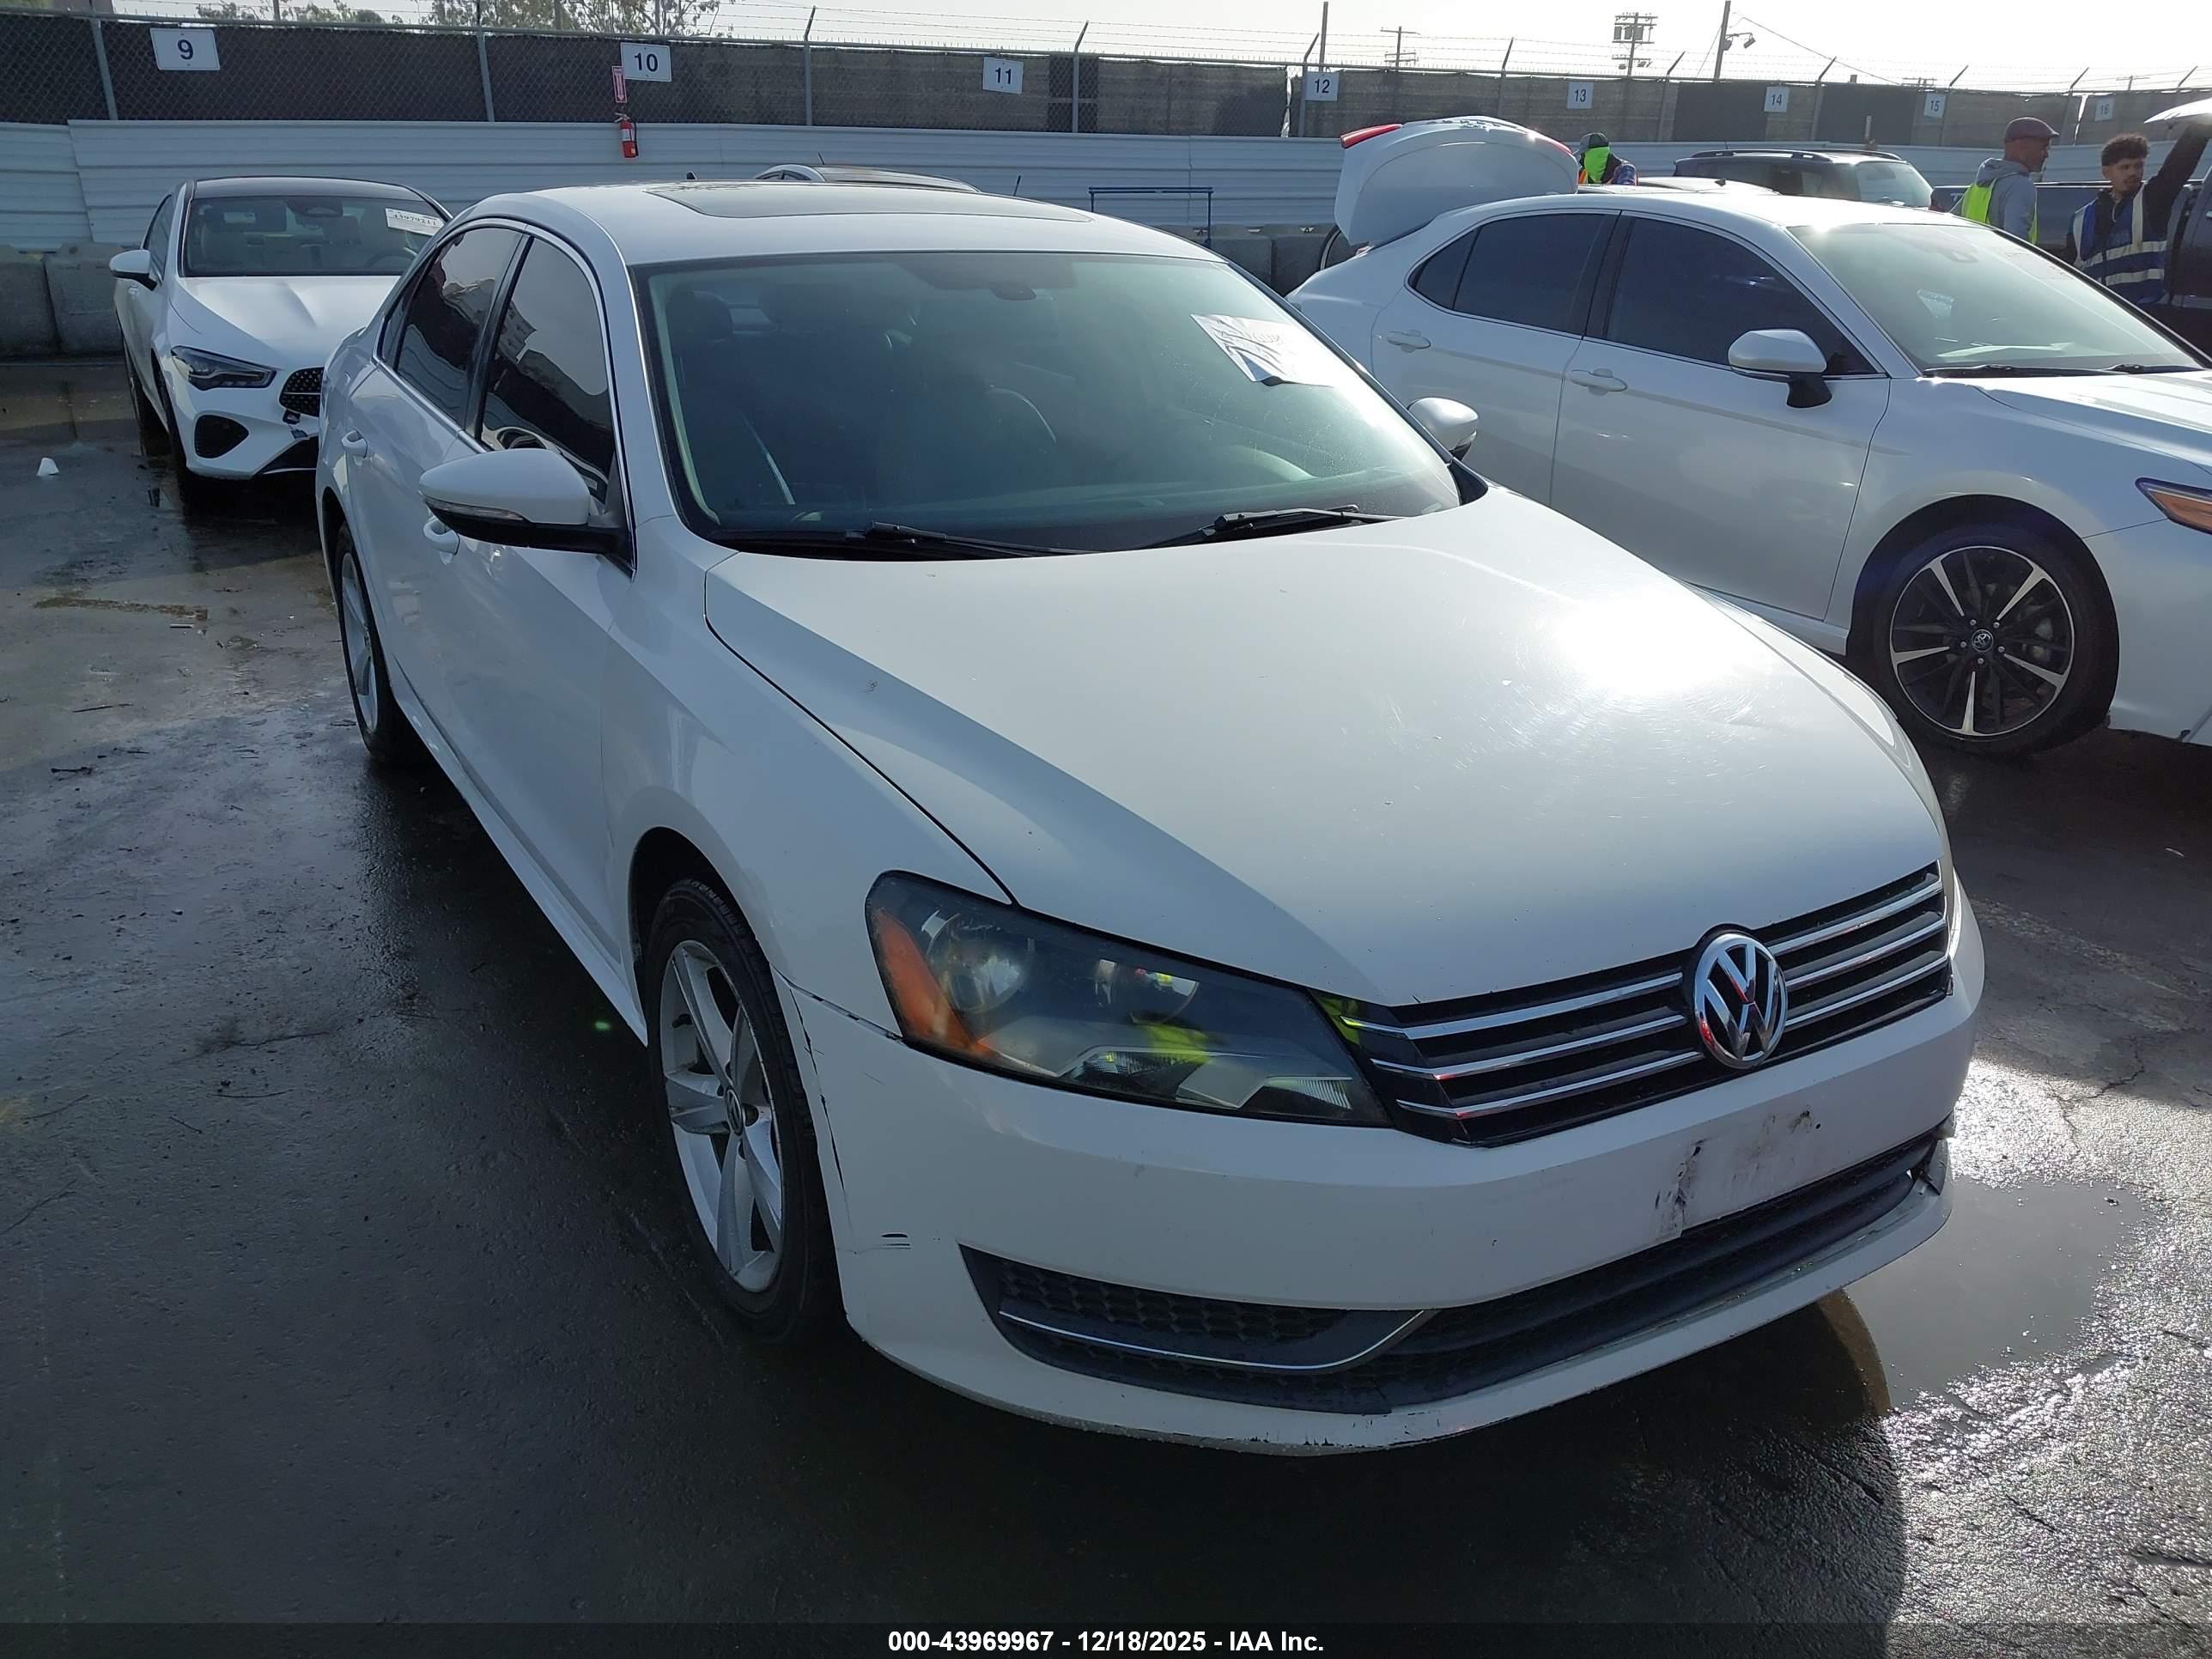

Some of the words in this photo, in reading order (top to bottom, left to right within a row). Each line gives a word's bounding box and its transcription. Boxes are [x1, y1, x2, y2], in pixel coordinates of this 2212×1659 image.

[178, 40, 193, 60] 9
[634, 52, 659, 72] 10
[994, 67, 1012, 84] 11
[1315, 78, 1330, 94] 12
[1574, 88, 1587, 103] 13
[1771, 94, 1783, 106] 14
[1930, 100, 1941, 112] 15
[2100, 103, 2110, 116] 16
